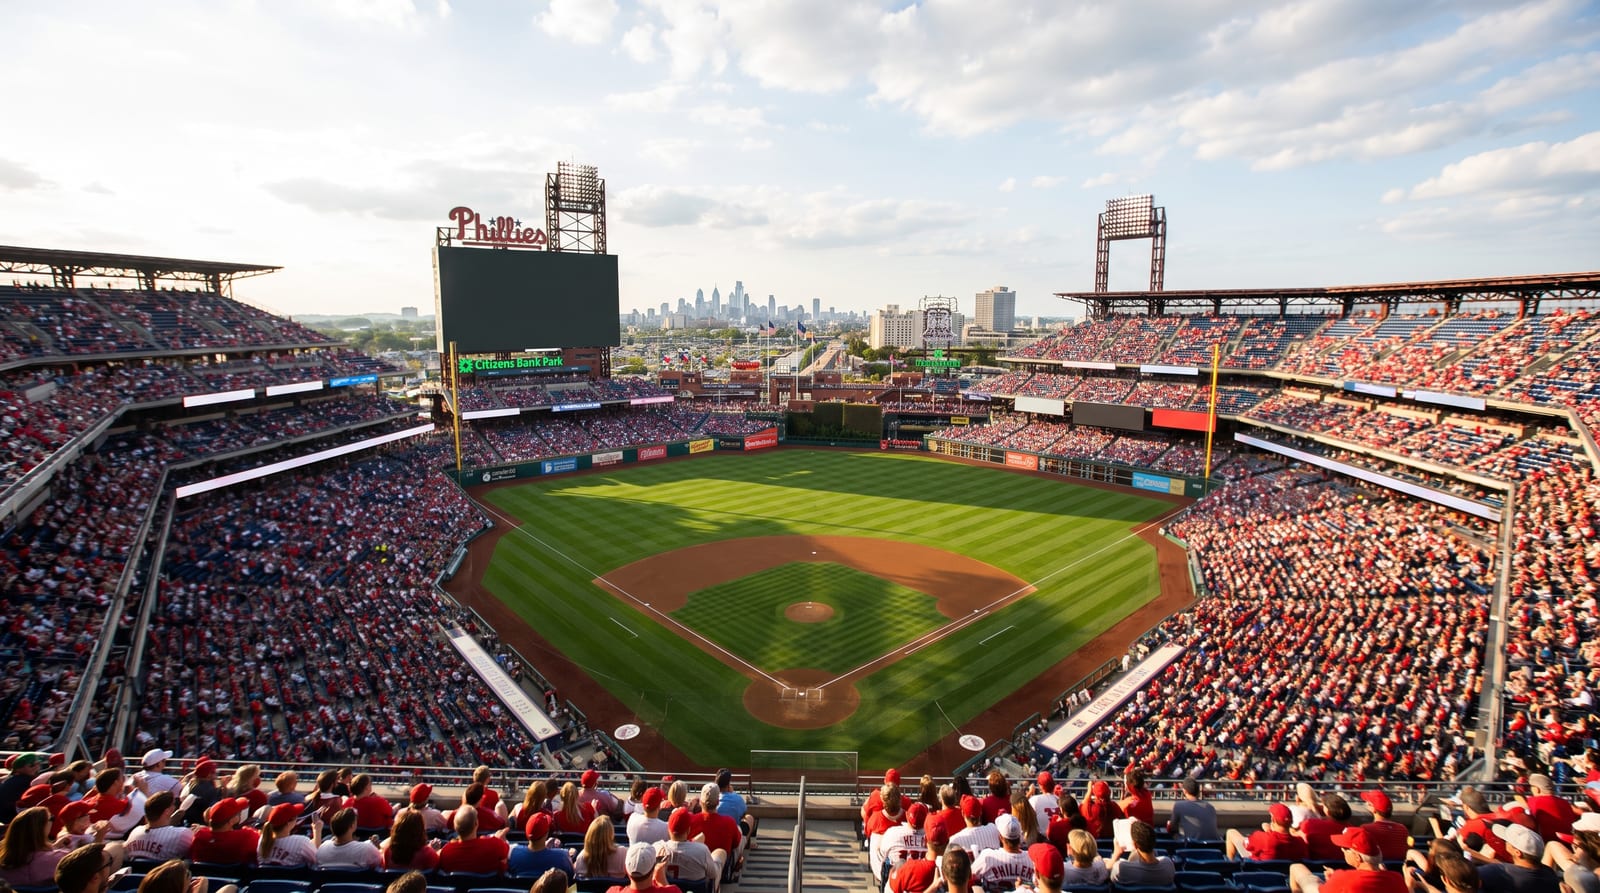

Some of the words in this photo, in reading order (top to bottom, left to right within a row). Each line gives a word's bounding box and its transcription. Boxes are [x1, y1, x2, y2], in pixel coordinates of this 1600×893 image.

[449, 206, 548, 245] Phillies
[475, 358, 515, 370] Citizens
[517, 357, 541, 368] Bank
[542, 356, 563, 367] Park
